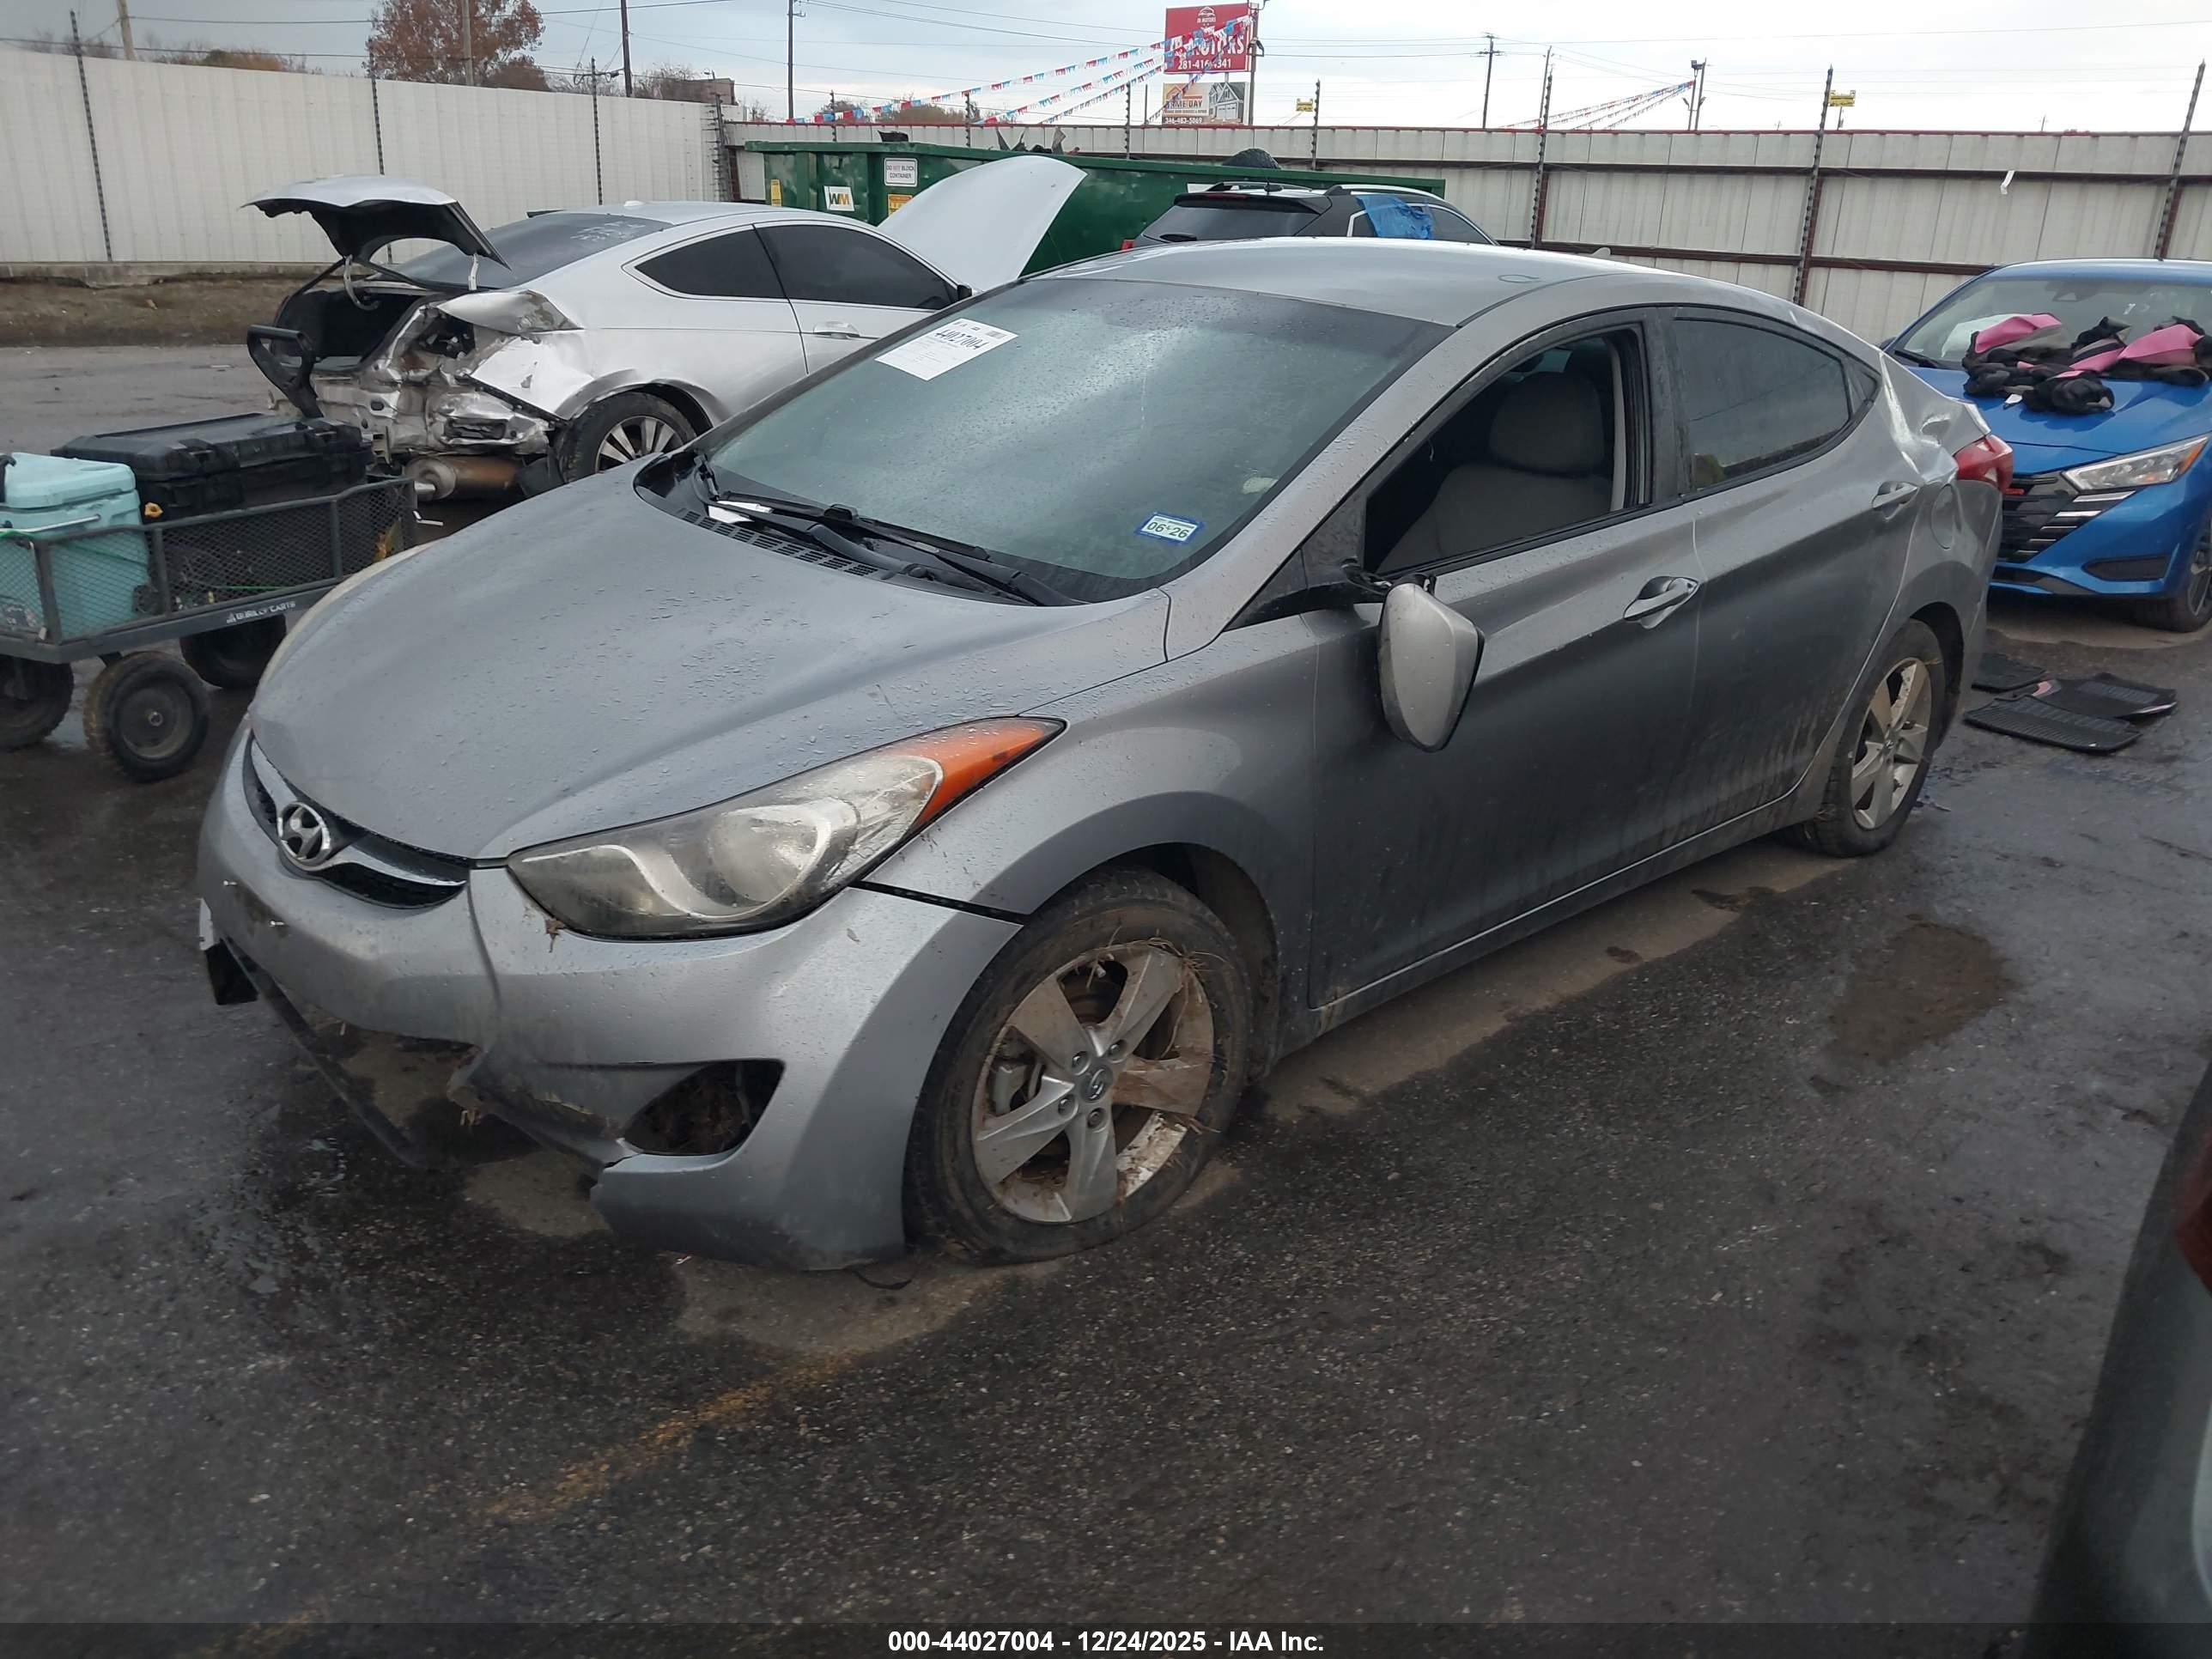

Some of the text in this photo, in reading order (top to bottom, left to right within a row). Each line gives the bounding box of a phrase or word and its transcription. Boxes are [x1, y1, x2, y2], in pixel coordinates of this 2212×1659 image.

[1178, 58, 1231, 70] 281-416341
[830, 193, 849, 205] WM
[1147, 521, 1166, 532] 06
[1169, 526, 1188, 538] 26
